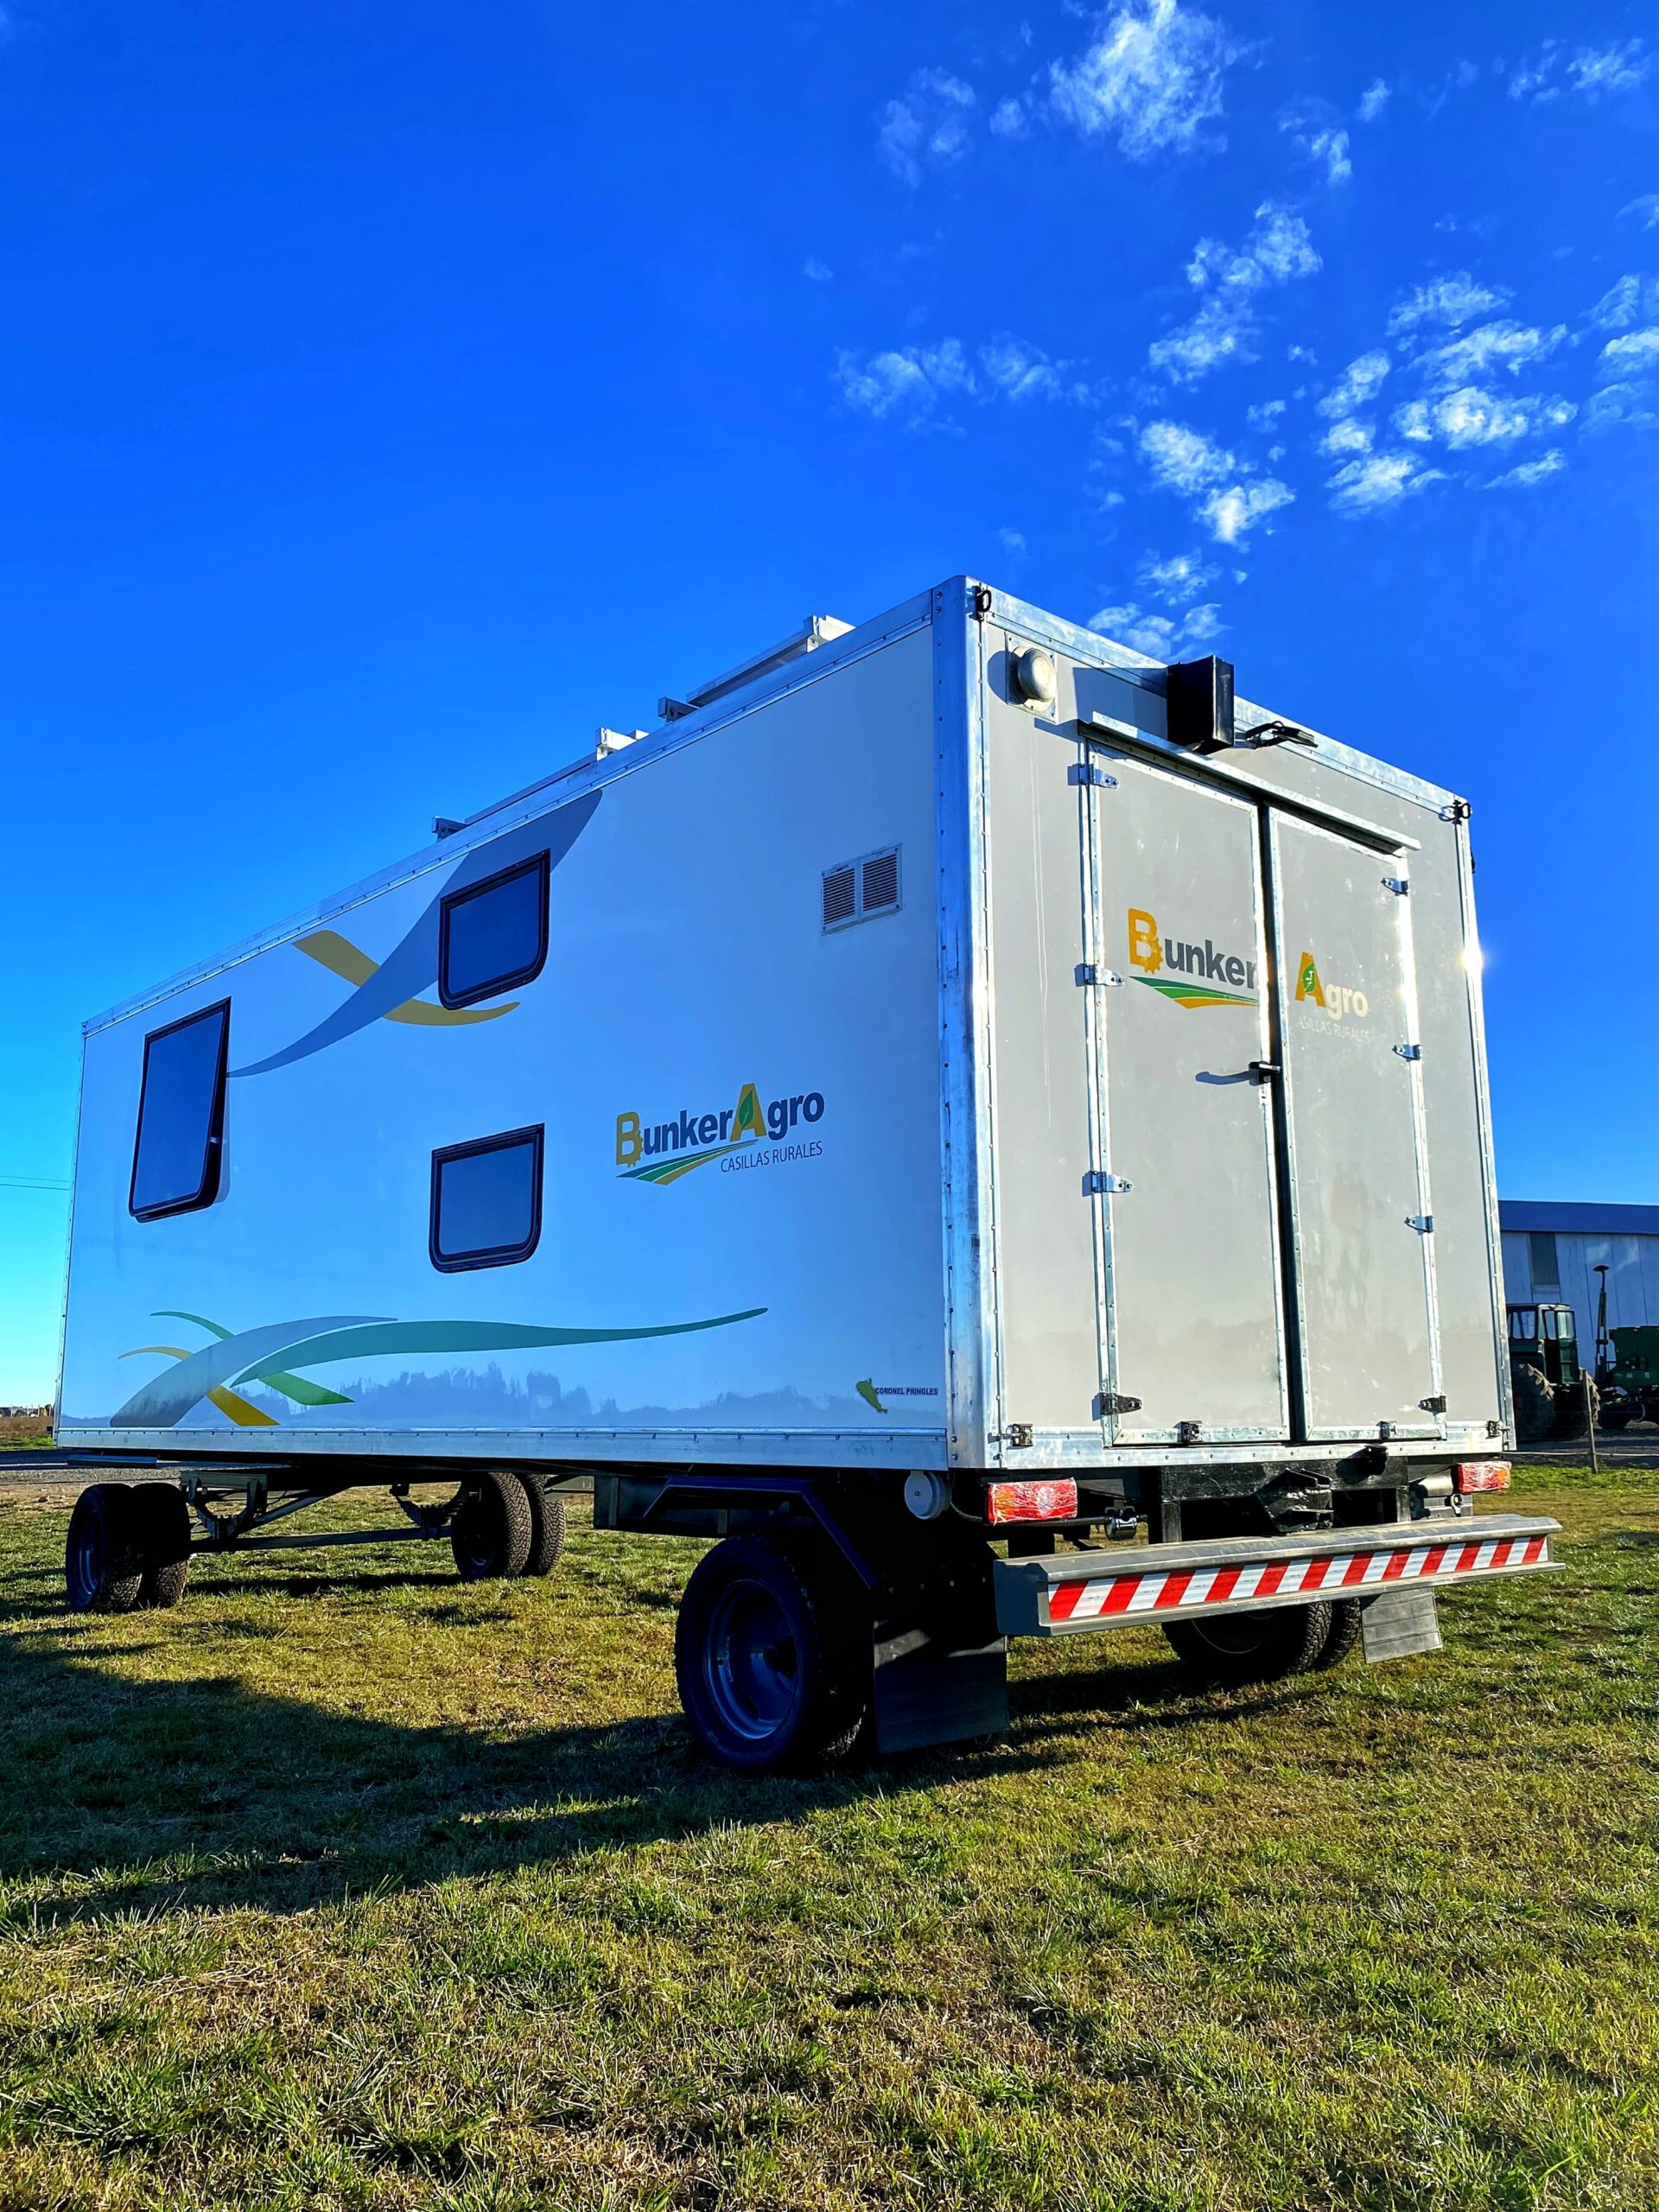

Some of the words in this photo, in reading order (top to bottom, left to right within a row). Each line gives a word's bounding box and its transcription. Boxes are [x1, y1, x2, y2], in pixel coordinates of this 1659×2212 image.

[1128, 908, 1257, 990] Bunker
[1294, 951, 1369, 1020] Agro
[721, 1151, 770, 1173] CASILLAS
[772, 1141, 823, 1164] RURALES
